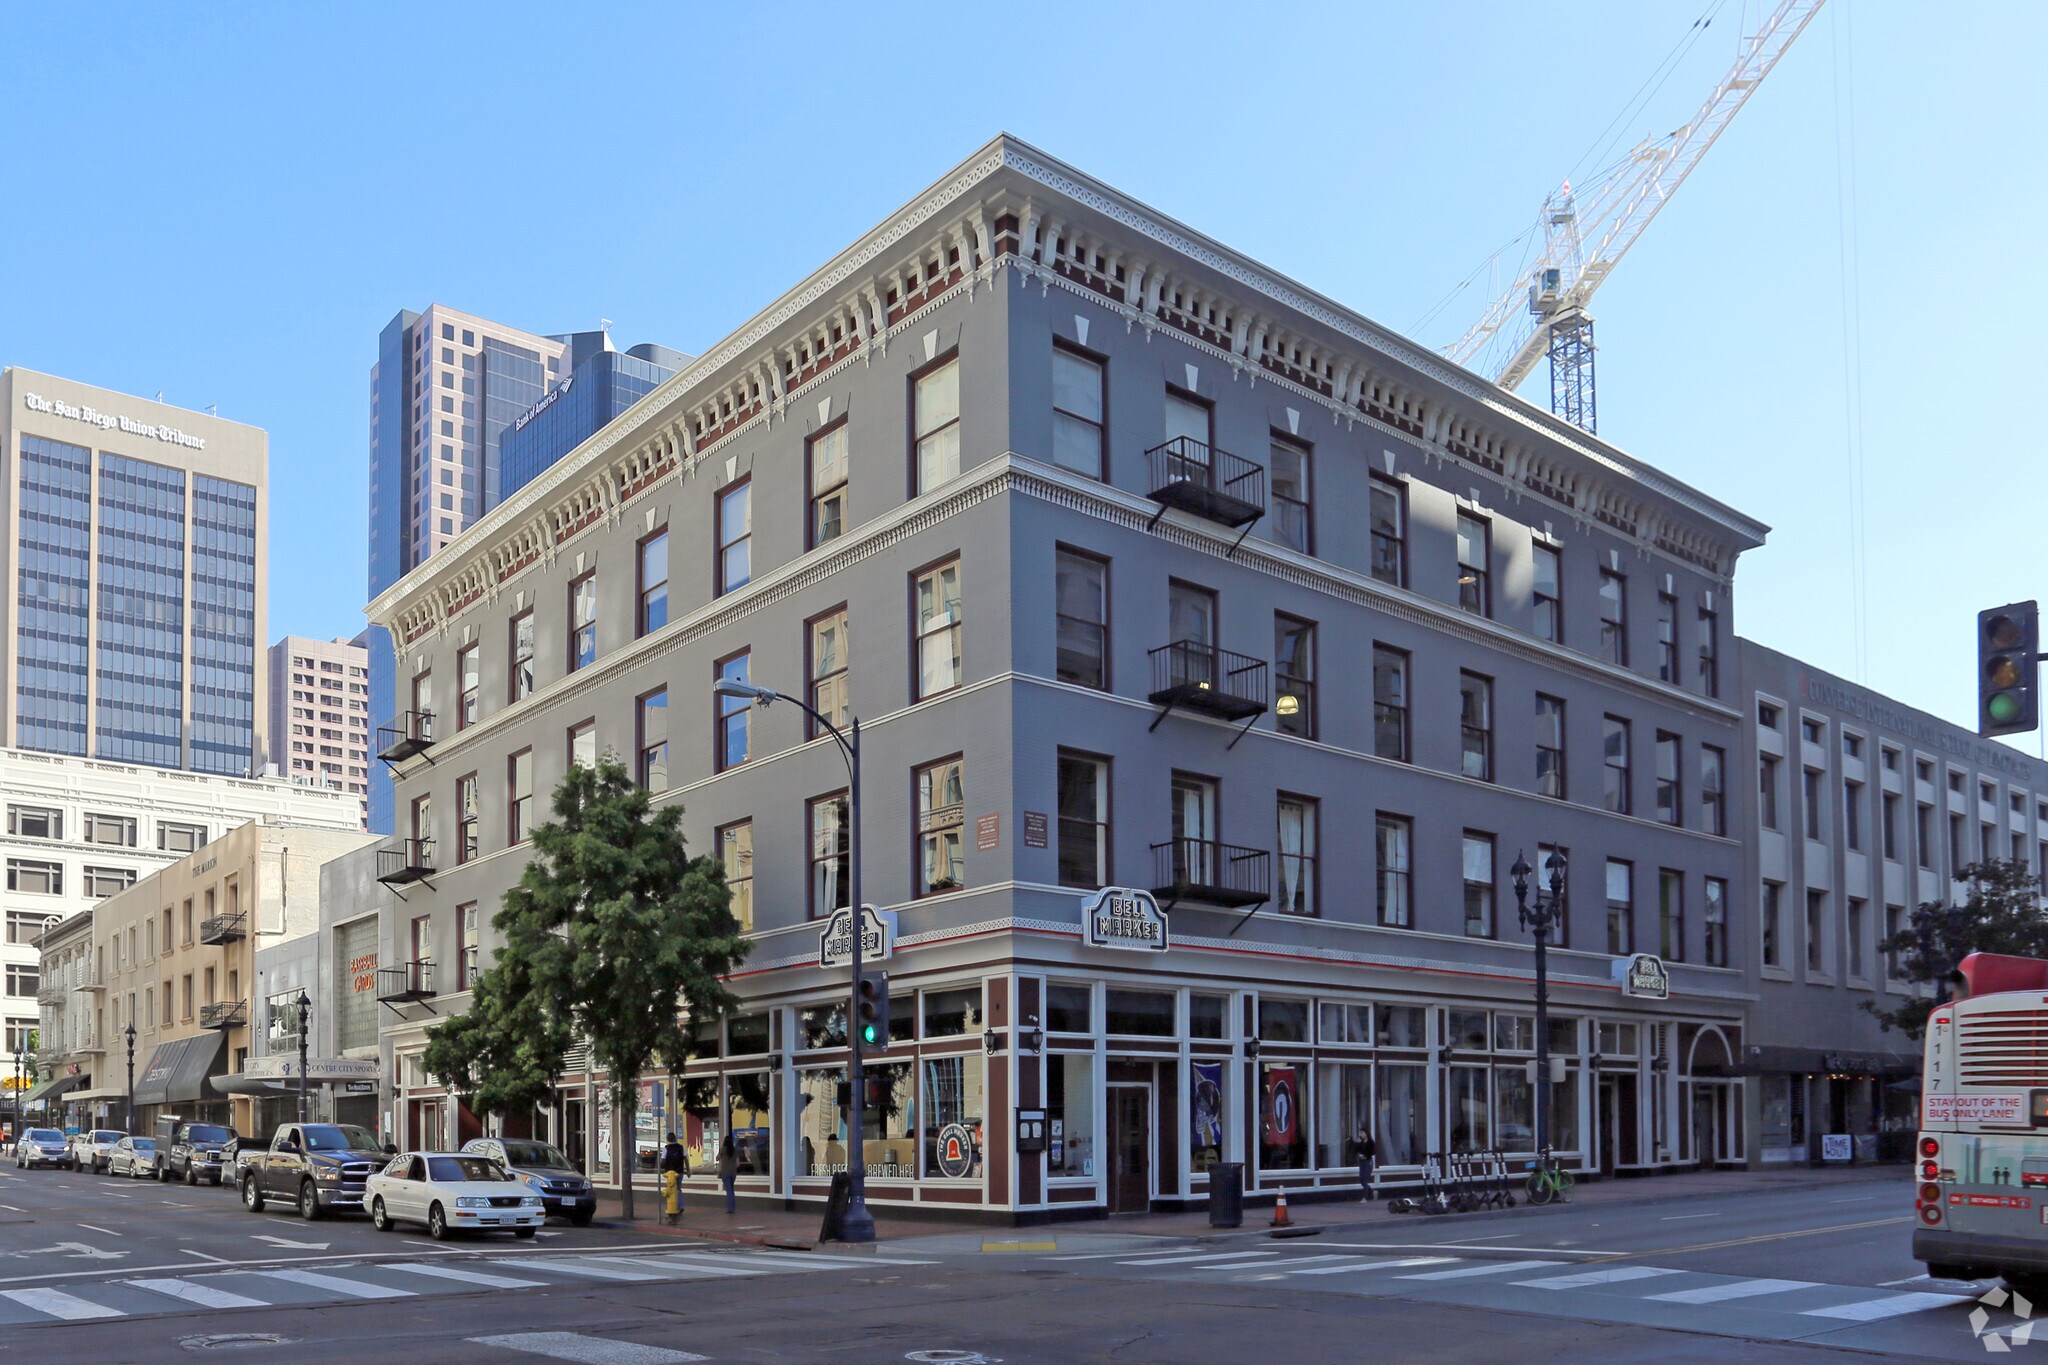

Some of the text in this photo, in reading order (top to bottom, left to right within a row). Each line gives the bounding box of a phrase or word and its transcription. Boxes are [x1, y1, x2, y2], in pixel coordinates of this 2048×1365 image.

[26, 392, 206, 449] The San Diego Union-Tribune
[516, 411, 530, 431] Bank
[535, 390, 558, 416] America
[192, 865, 200, 878] THE
[1110, 897, 1147, 919] BELL
[835, 914, 869, 935] BEL
[1097, 916, 1161, 940] MARKER
[825, 931, 879, 957] MARER
[350, 953, 378, 974] BASEBALL
[354, 972, 375, 993] CARDS
[311, 1063, 377, 1073] CENTRE CITY SPORTS
[1929, 1098, 2020, 1107] STAY OUT OF THE
[1929, 1109, 2015, 1118] BUS ONLY LANE!
[1827, 1137, 1848, 1147] TIME
[1829, 1148, 1848, 1157] OUT
[811, 1163, 831, 1177] FRESH
[867, 1163, 898, 1178] BREWED
[900, 1163, 915, 1178] HER
